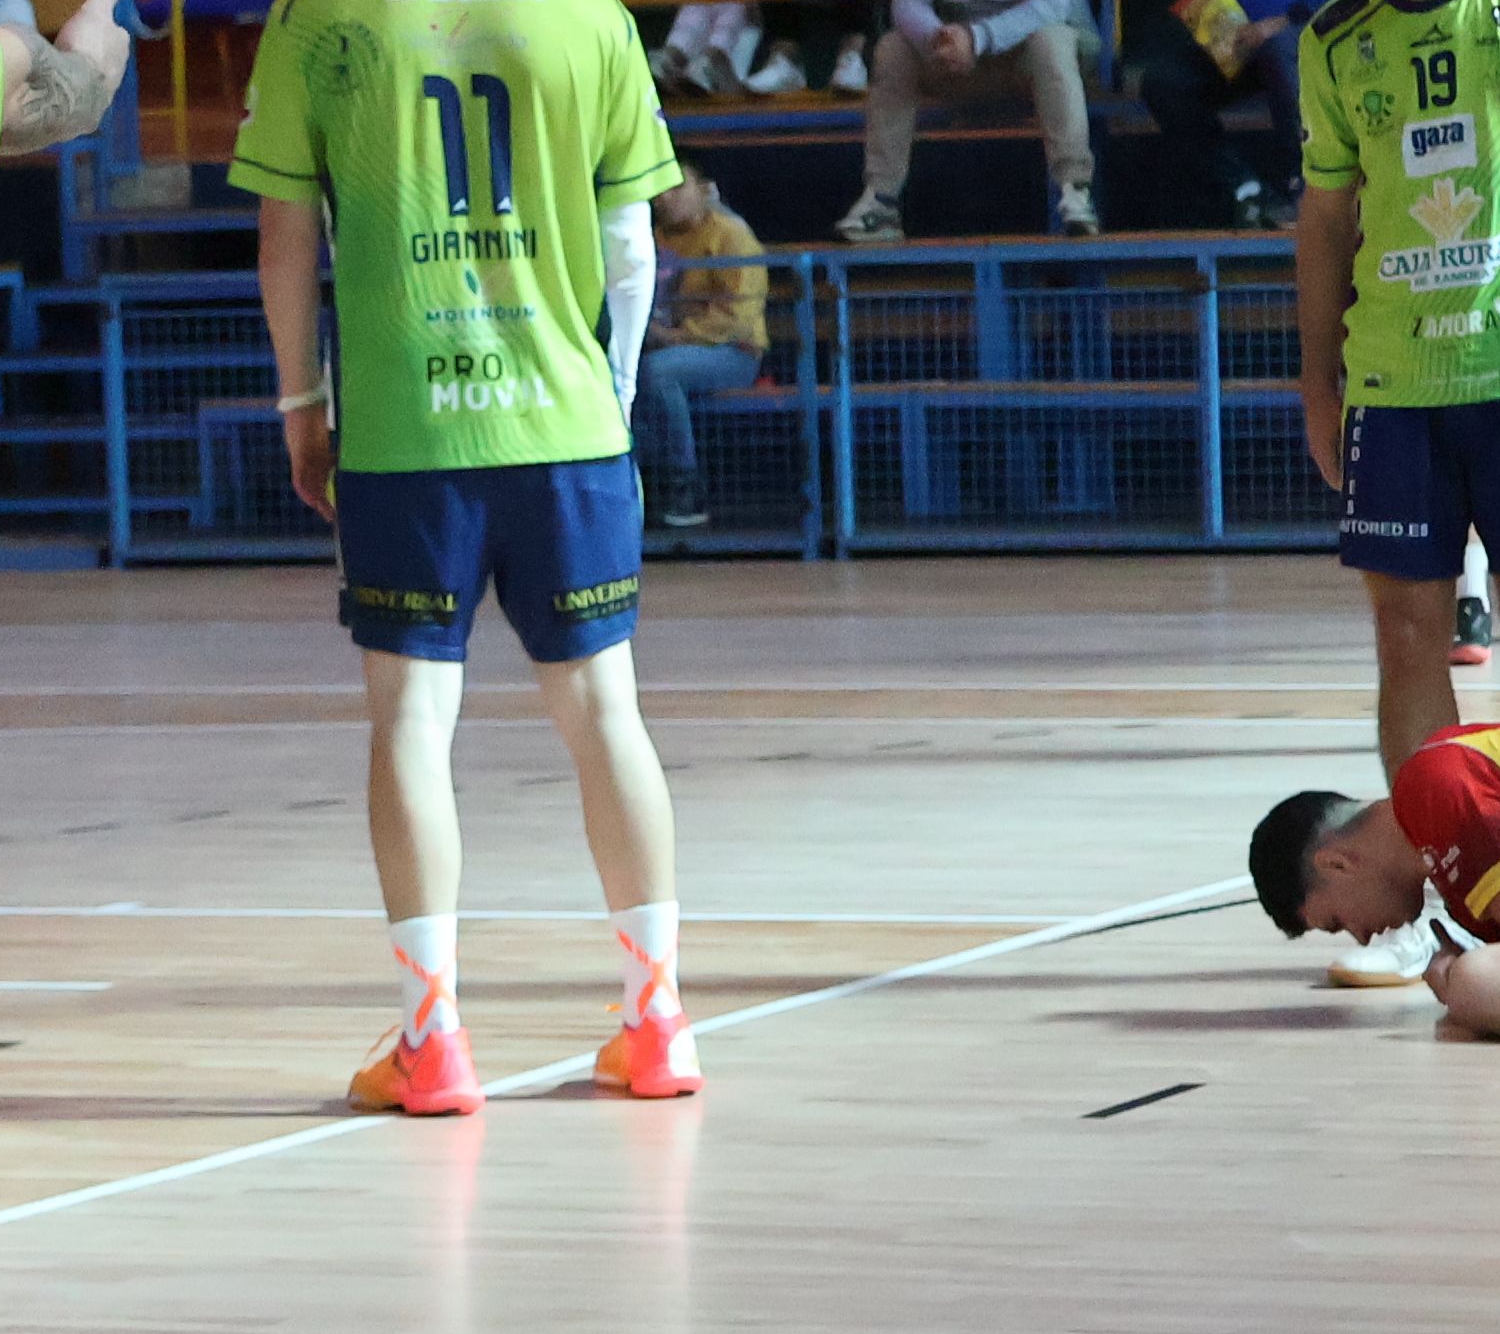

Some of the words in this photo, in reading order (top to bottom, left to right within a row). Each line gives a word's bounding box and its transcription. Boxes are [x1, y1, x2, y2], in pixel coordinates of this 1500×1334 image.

[1411, 50, 1458, 111] 19
[423, 73, 513, 216] 11
[1411, 122, 1465, 156] gaza
[412, 229, 537, 263] GIANNINI
[427, 354, 502, 383] PRO
